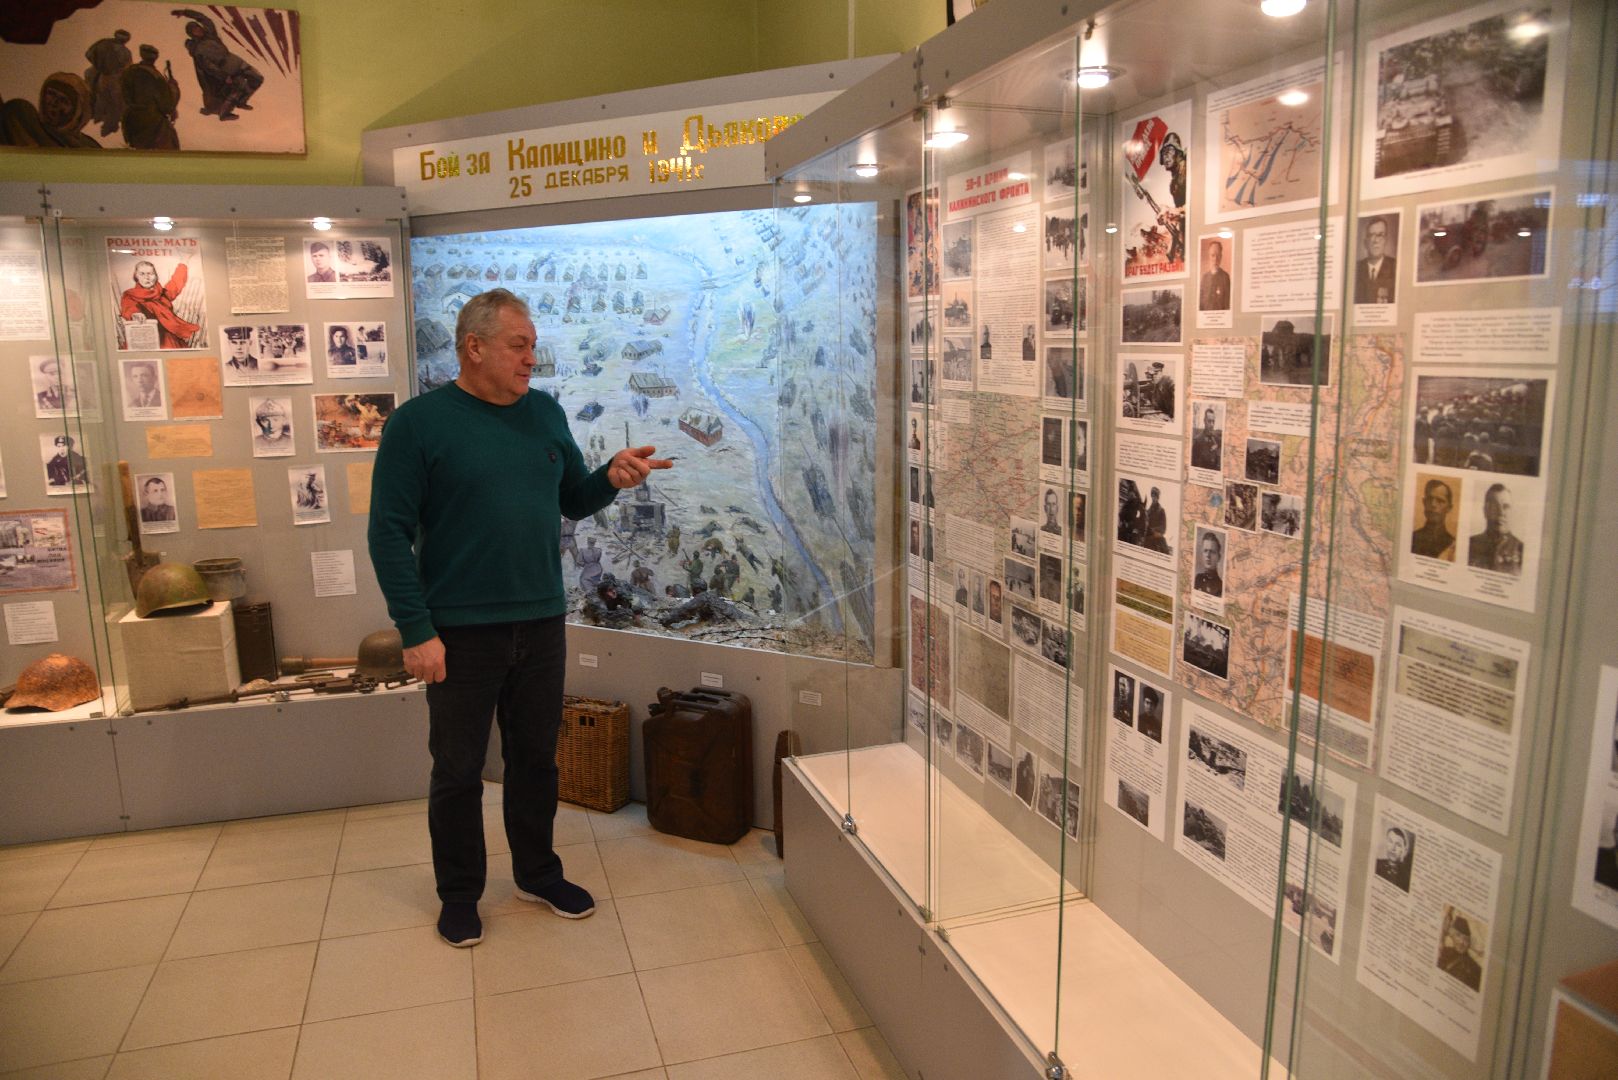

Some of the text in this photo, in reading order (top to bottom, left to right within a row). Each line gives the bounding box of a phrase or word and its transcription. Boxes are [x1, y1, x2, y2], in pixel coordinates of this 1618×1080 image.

[420, 150, 460, 181] Бой
[466, 151, 490, 176] за
[641, 129, 658, 155] и
[509, 174, 532, 199] 25
[544, 165, 629, 189] ДЕКАБРЯ
